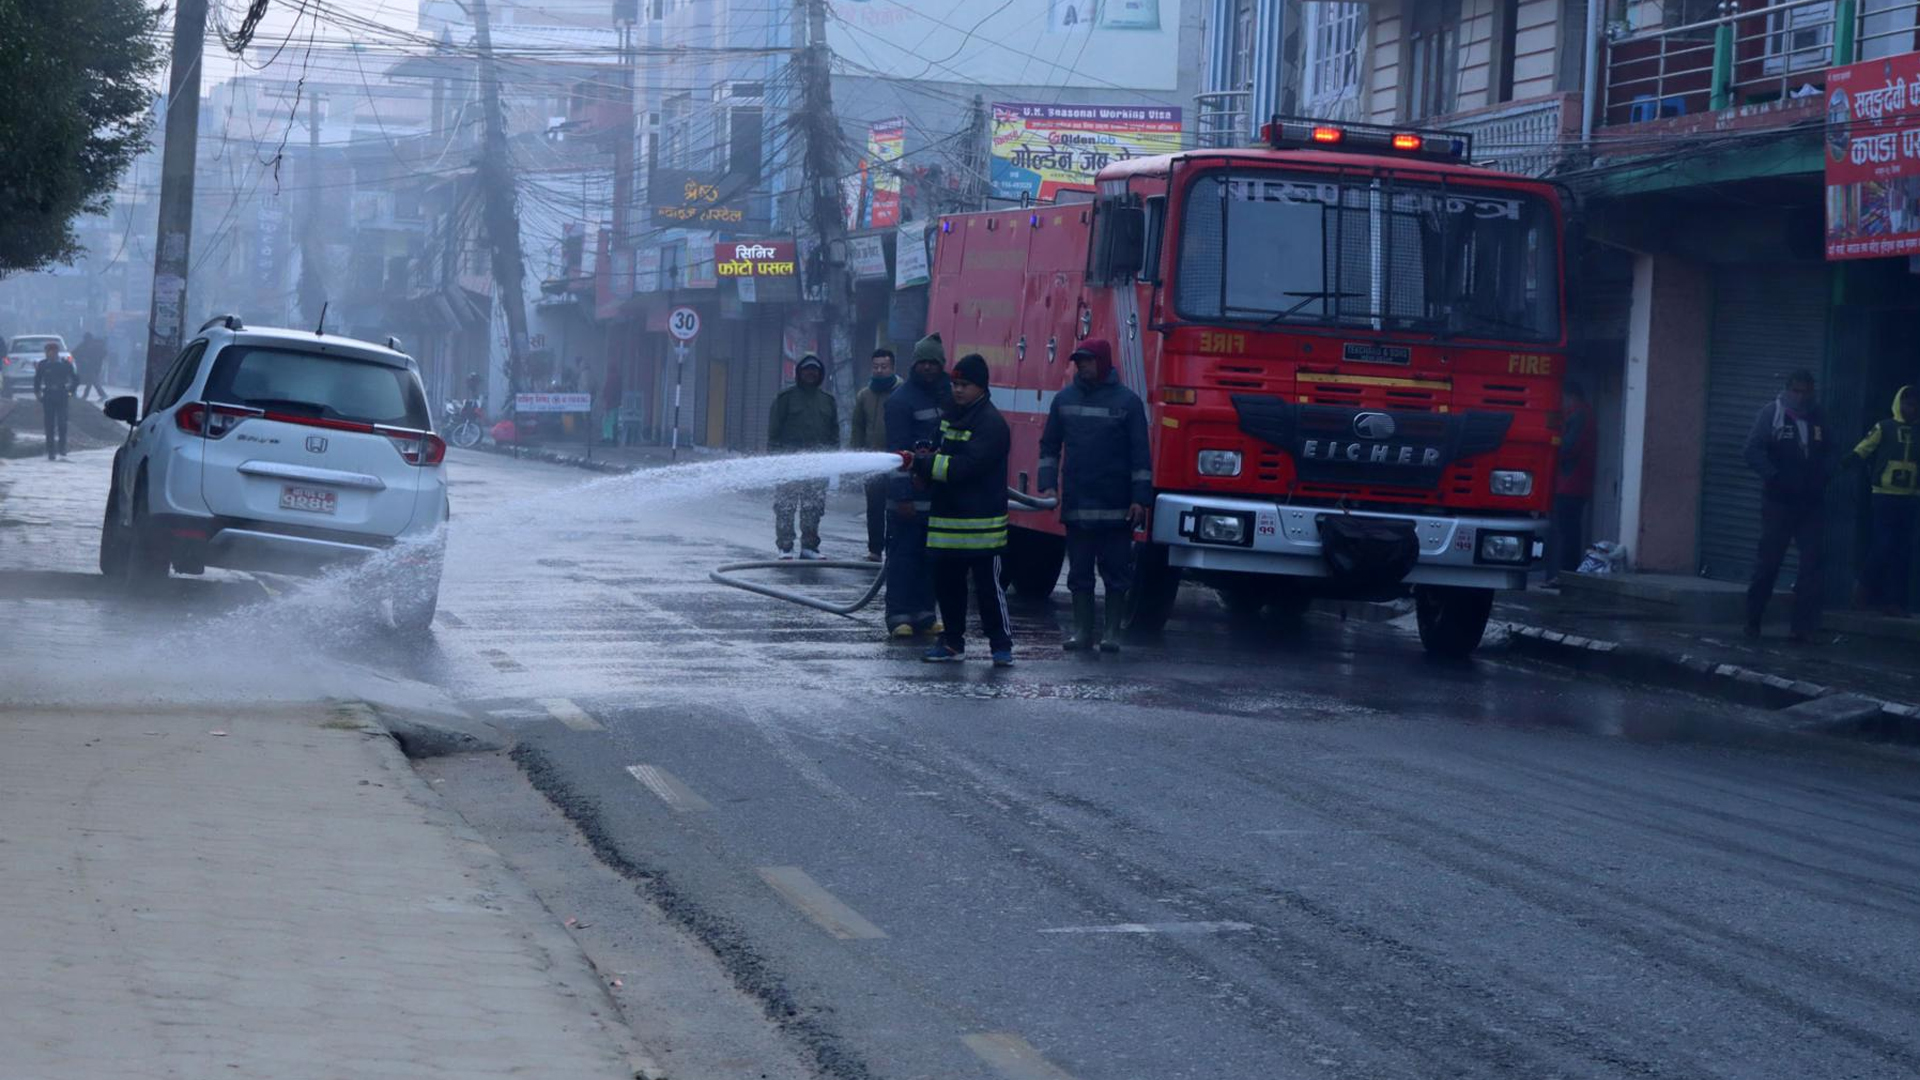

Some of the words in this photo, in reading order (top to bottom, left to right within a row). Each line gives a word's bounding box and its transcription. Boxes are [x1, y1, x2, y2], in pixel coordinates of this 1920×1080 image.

[1048, 109, 1096, 118] Seasonal
[1100, 109, 1145, 119] Working
[1149, 110, 1171, 119] Visa
[1851, 133, 1898, 166] कपडा
[718, 259, 754, 276] फोटो
[758, 261, 794, 276] पसल
[675, 311, 695, 331] 30
[1508, 354, 1552, 376] FIRE
[1303, 440, 1439, 465] EICHER
